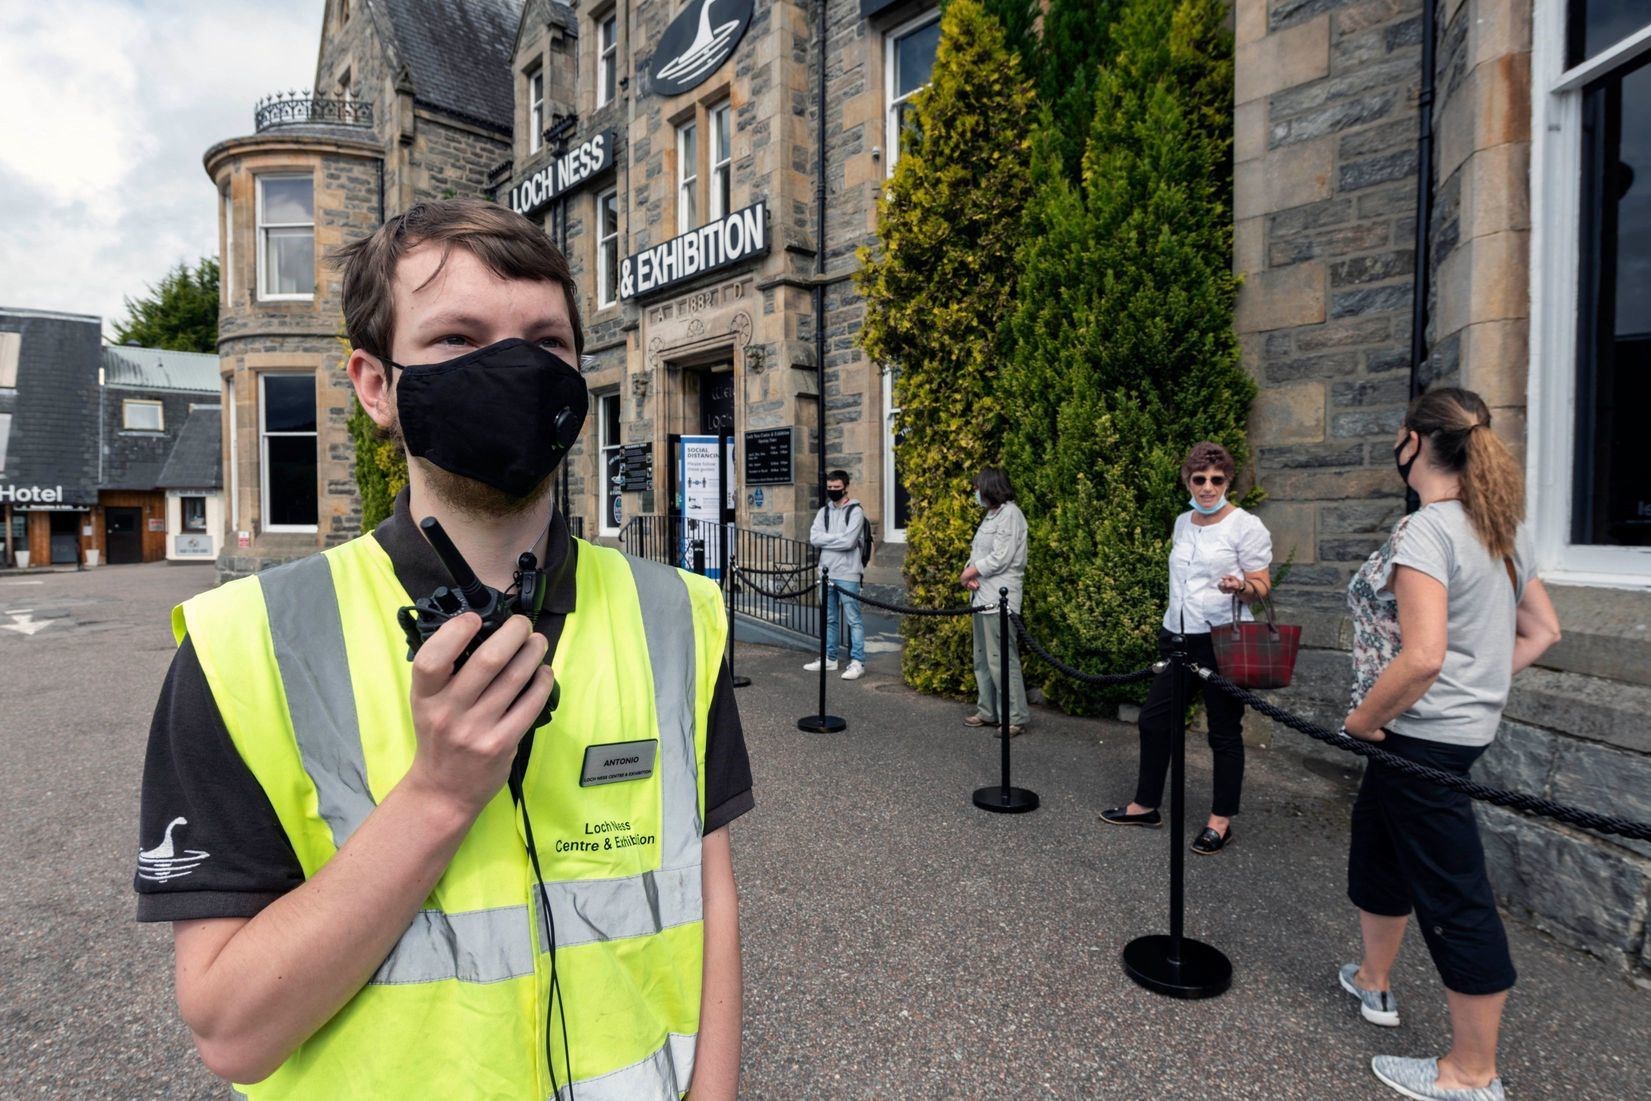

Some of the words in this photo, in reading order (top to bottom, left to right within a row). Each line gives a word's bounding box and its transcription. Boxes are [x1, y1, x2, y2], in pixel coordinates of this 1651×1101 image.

[512, 171, 553, 215] LOCH
[557, 134, 604, 190] NESS
[620, 259, 634, 298] &
[637, 203, 764, 294] EXHIBITION
[0, 484, 63, 502] Hotel
[603, 756, 639, 767] ANTONIO
[585, 821, 612, 834] Loch
[611, 821, 631, 831] Ness
[555, 840, 599, 853] Centre
[604, 837, 612, 850] &
